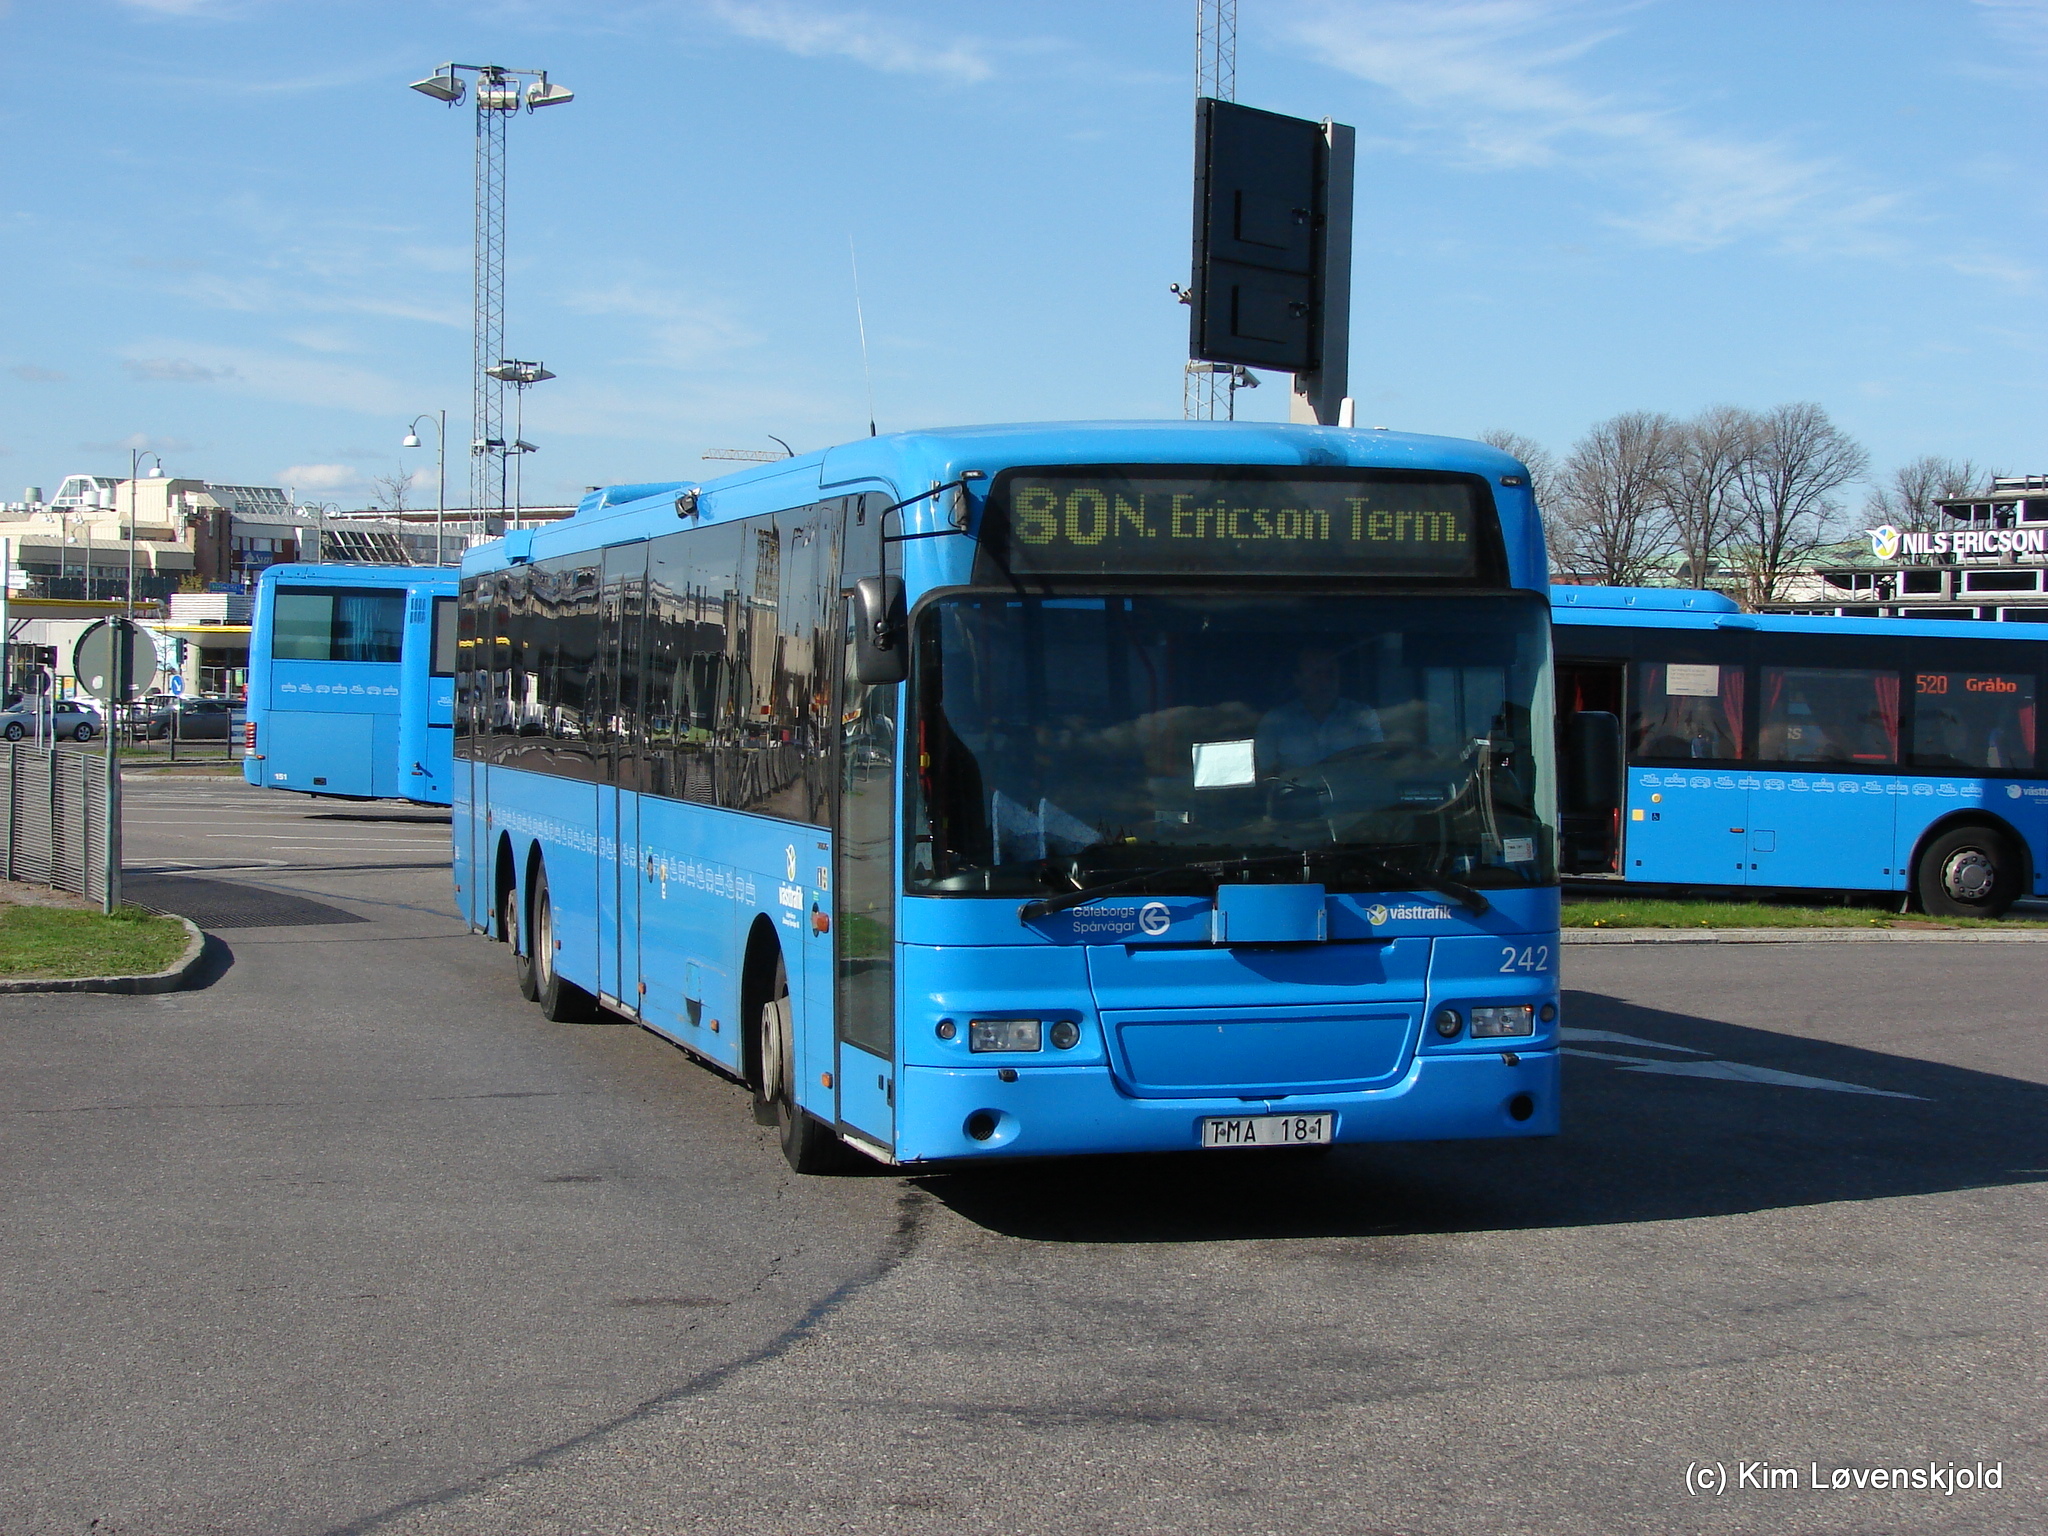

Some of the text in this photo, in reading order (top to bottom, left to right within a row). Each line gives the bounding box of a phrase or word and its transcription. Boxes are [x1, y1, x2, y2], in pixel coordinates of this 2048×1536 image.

[1171, 494, 1330, 540] Ericson
[1345, 497, 1467, 542] Term.
[1902, 529, 2044, 554] NILS ERICSON
[1916, 674, 2017, 694] 520 Gråbo
[1072, 906, 1135, 919] Göteborgs
[1389, 905, 1452, 920] västtrafik
[1072, 921, 1136, 934] Spårvägar
[1499, 945, 1548, 973] 242
[1211, 1117, 1322, 1144] TMA 181
